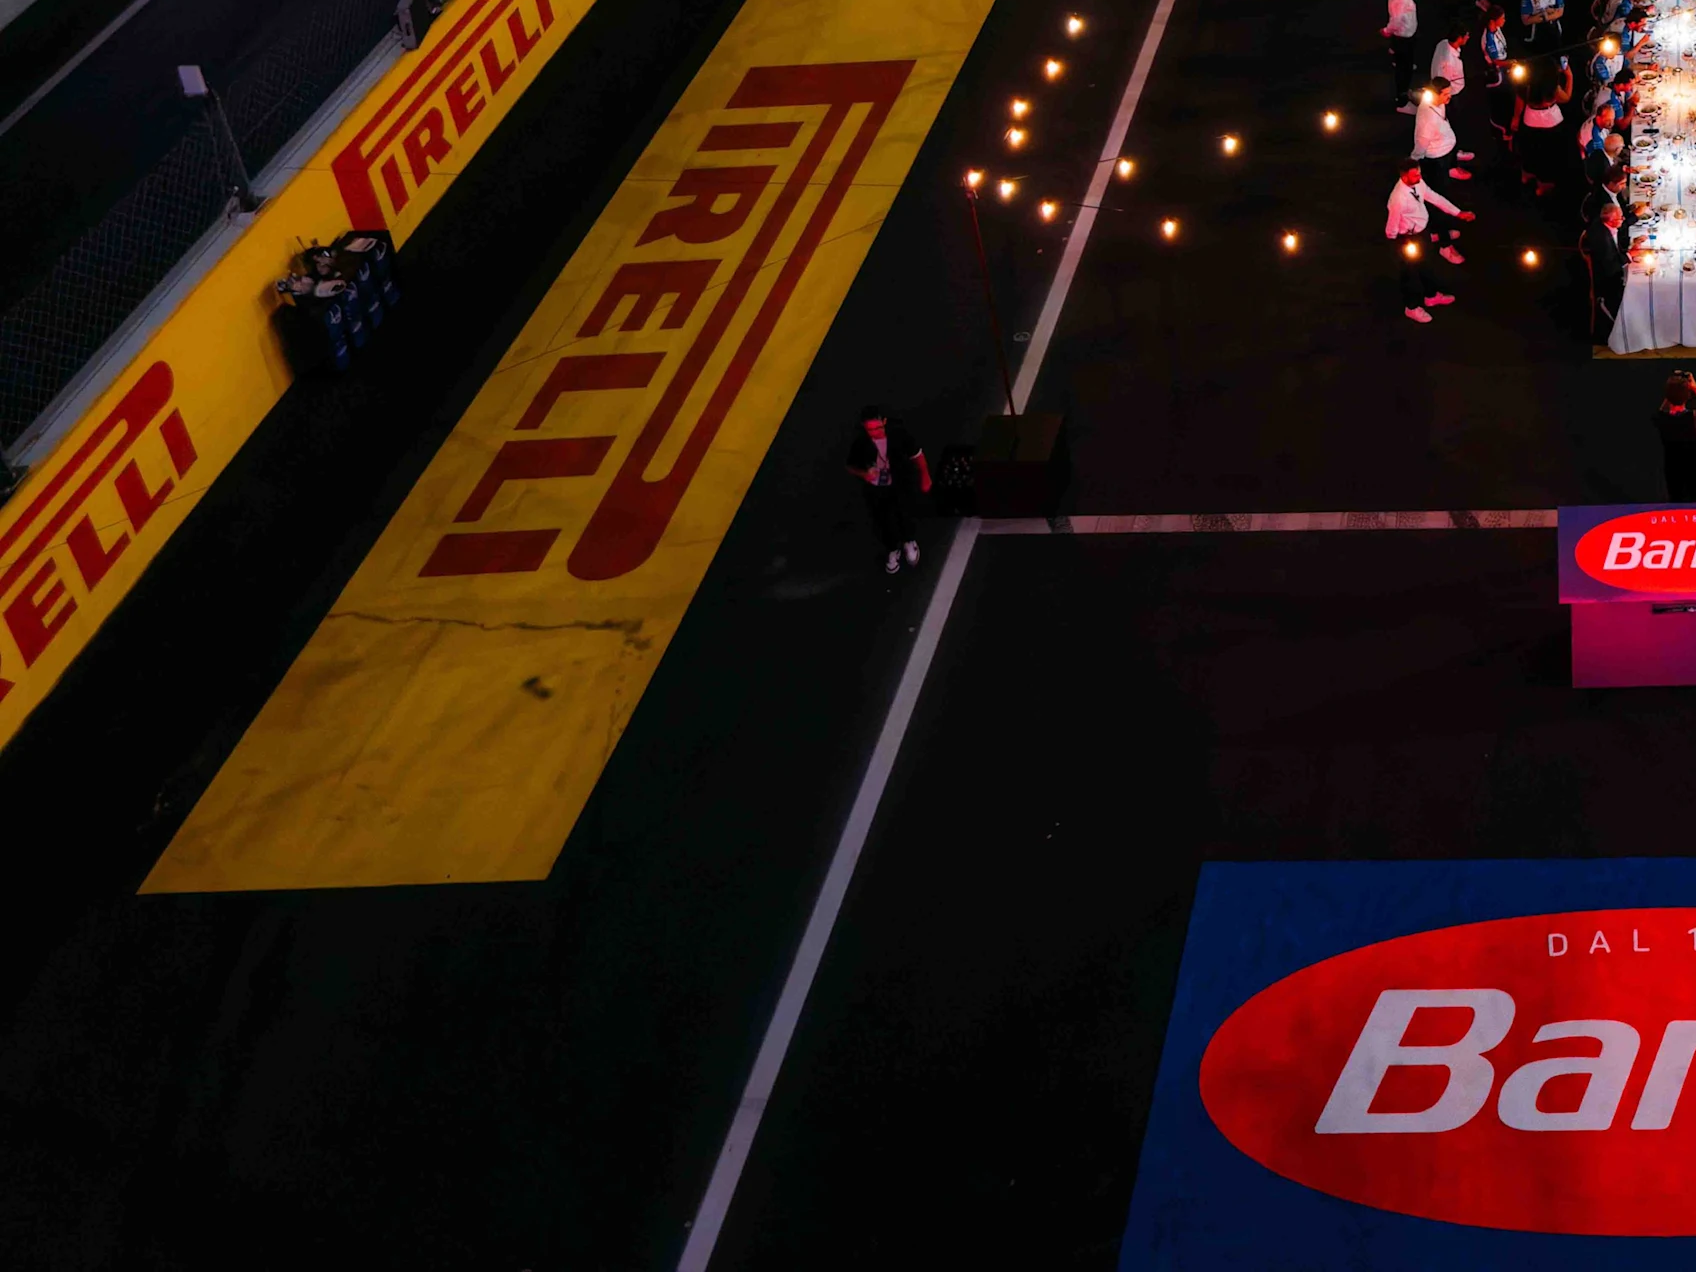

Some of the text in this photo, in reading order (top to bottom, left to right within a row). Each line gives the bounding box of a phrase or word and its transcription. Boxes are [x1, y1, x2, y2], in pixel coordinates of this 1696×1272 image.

[418, 59, 917, 581] PIRELLI
[1650, 515, 1677, 525] DAL
[1548, 930, 1652, 957] DAL
